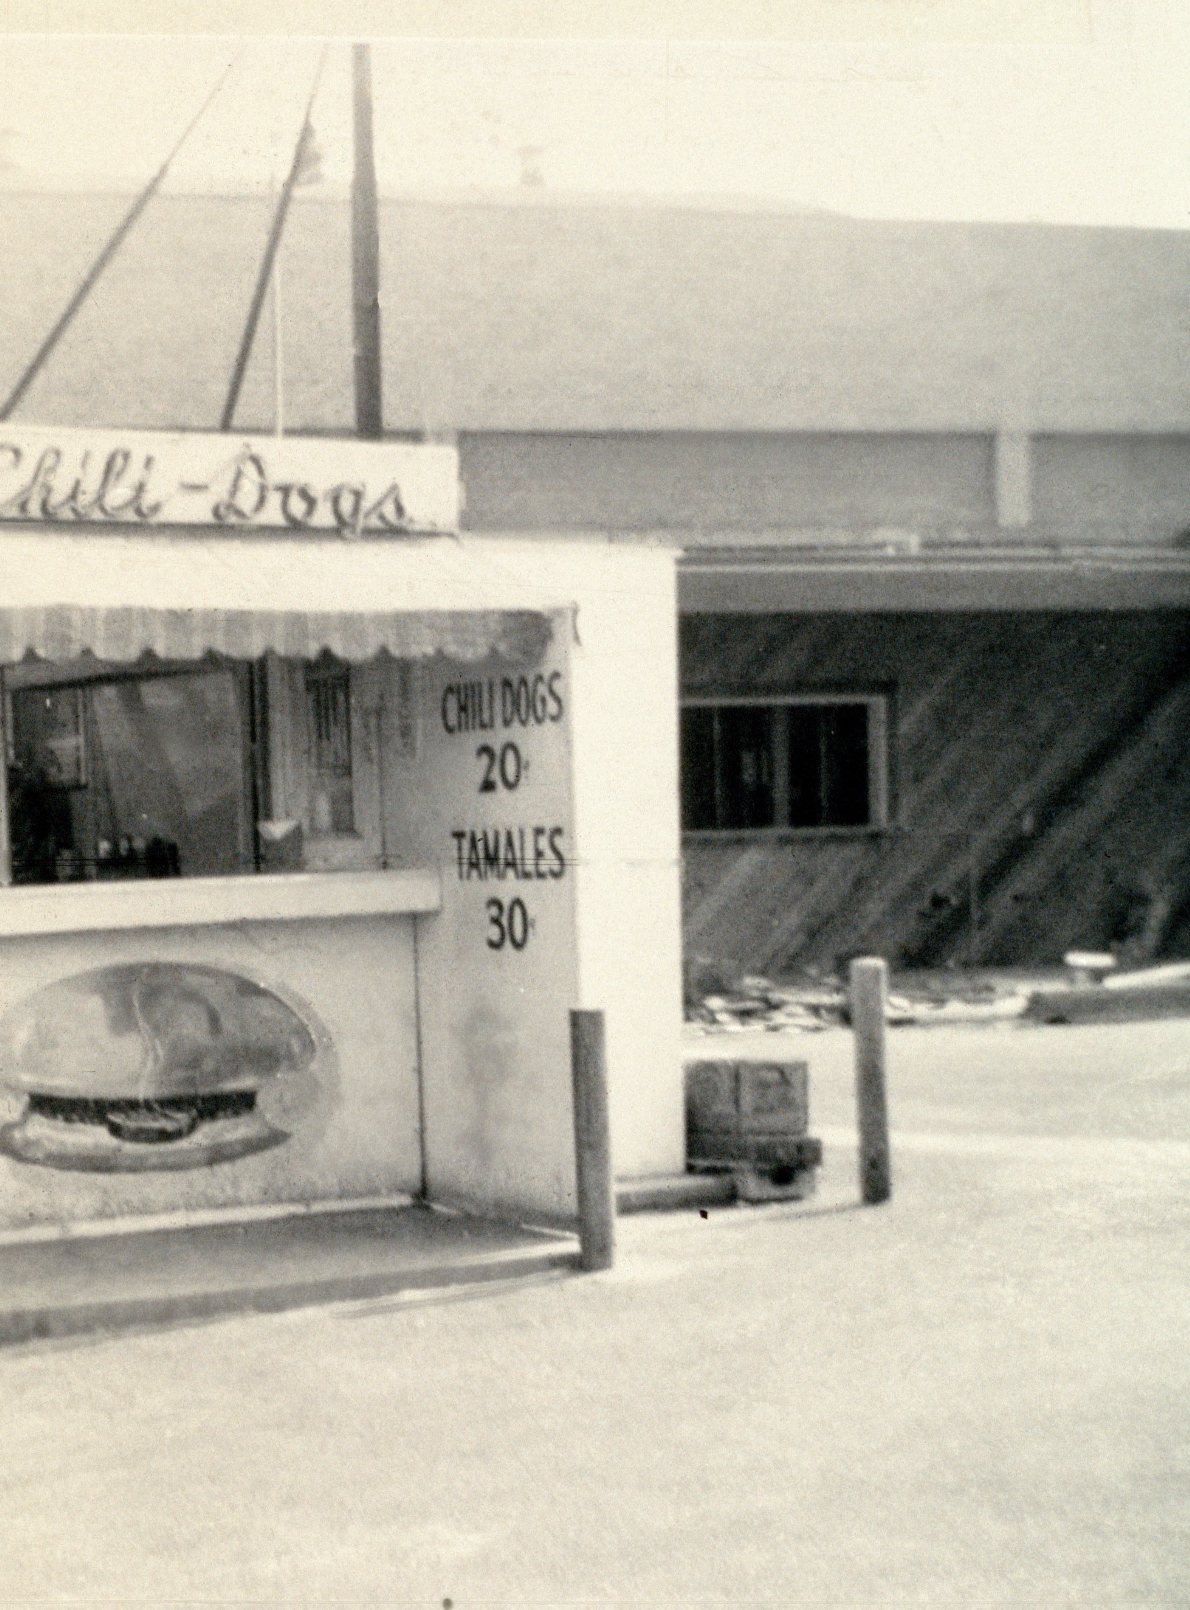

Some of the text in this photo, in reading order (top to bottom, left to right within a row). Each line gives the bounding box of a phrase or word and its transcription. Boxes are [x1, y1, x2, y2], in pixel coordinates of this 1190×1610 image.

[441, 670, 564, 735] CHILI DOGS
[451, 825, 566, 881] TAMALES
